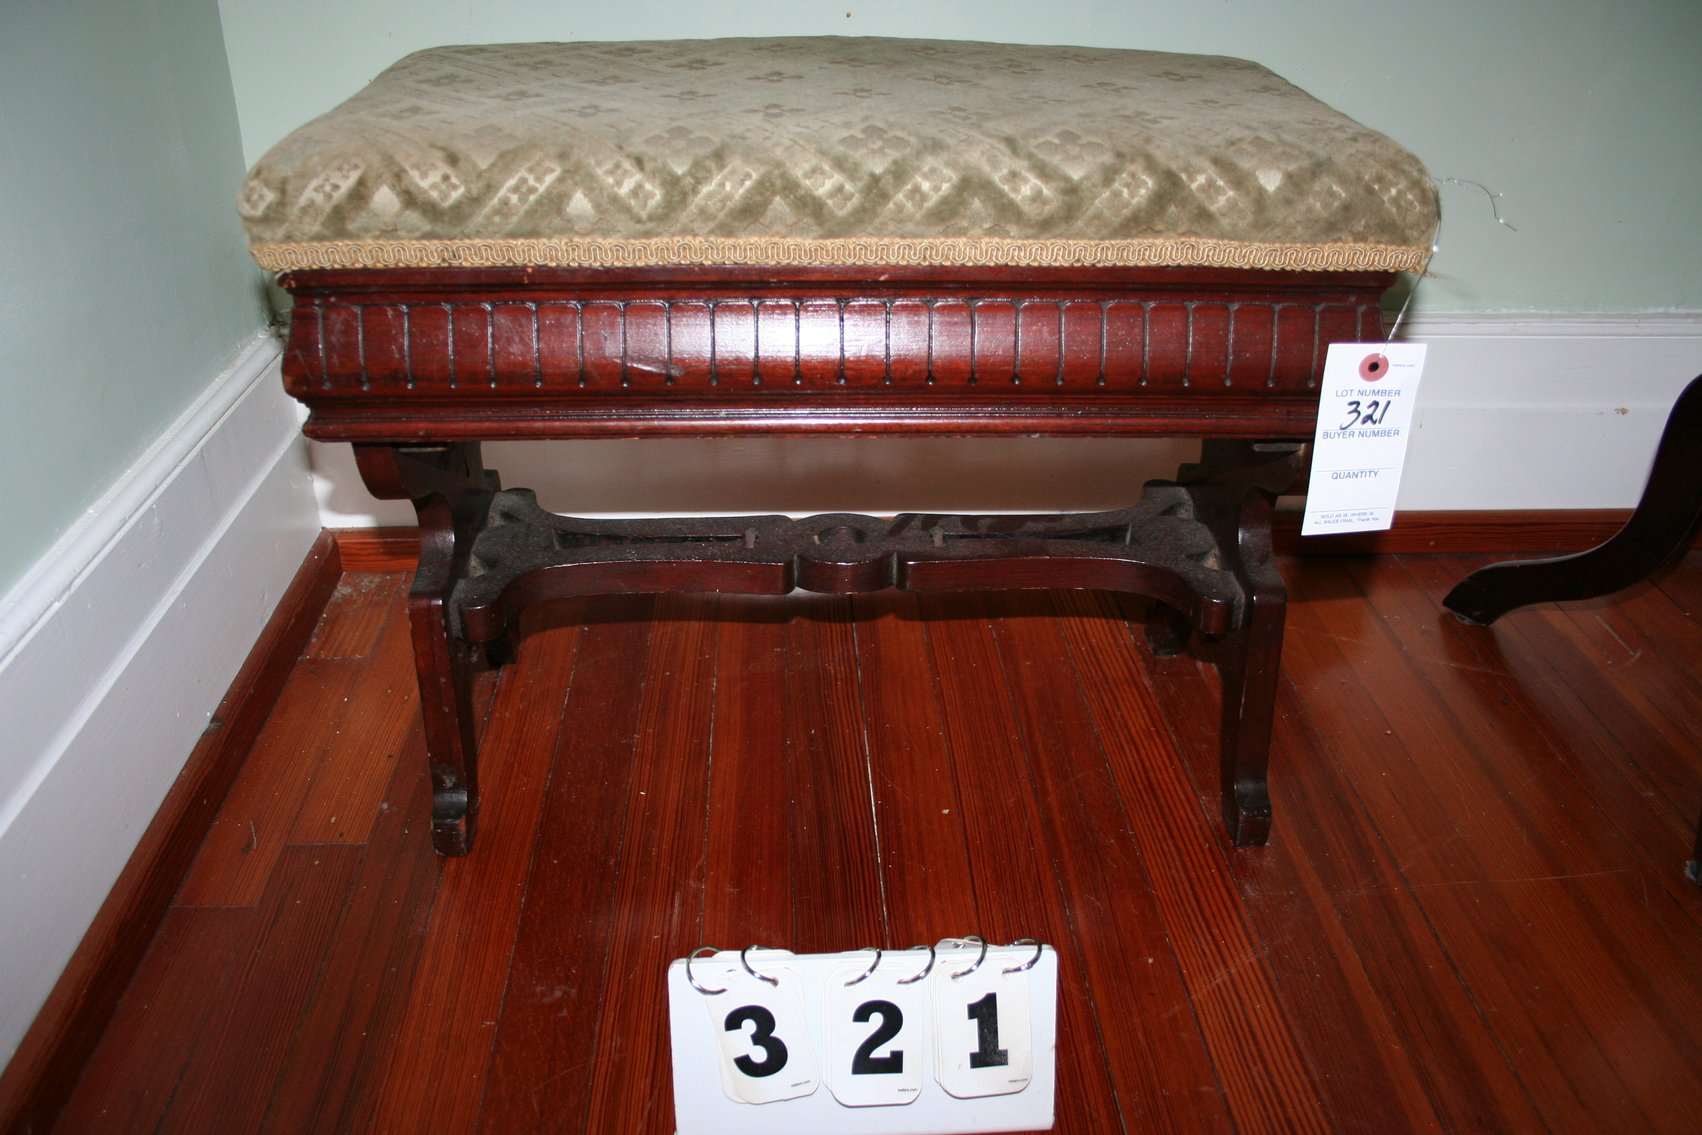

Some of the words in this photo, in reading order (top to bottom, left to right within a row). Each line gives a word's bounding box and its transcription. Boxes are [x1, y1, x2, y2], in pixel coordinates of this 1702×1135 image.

[1335, 389, 1354, 397] LOT
[1357, 389, 1401, 397] NUMBER
[1339, 400, 1391, 430] 321
[1322, 431, 1355, 439] BUYER
[1357, 429, 1400, 438] NUMBER
[1331, 470, 1379, 480] QUANTITY
[724, 1004, 789, 1078] 3
[851, 999, 904, 1075] 2
[966, 992, 1009, 1069] 1
